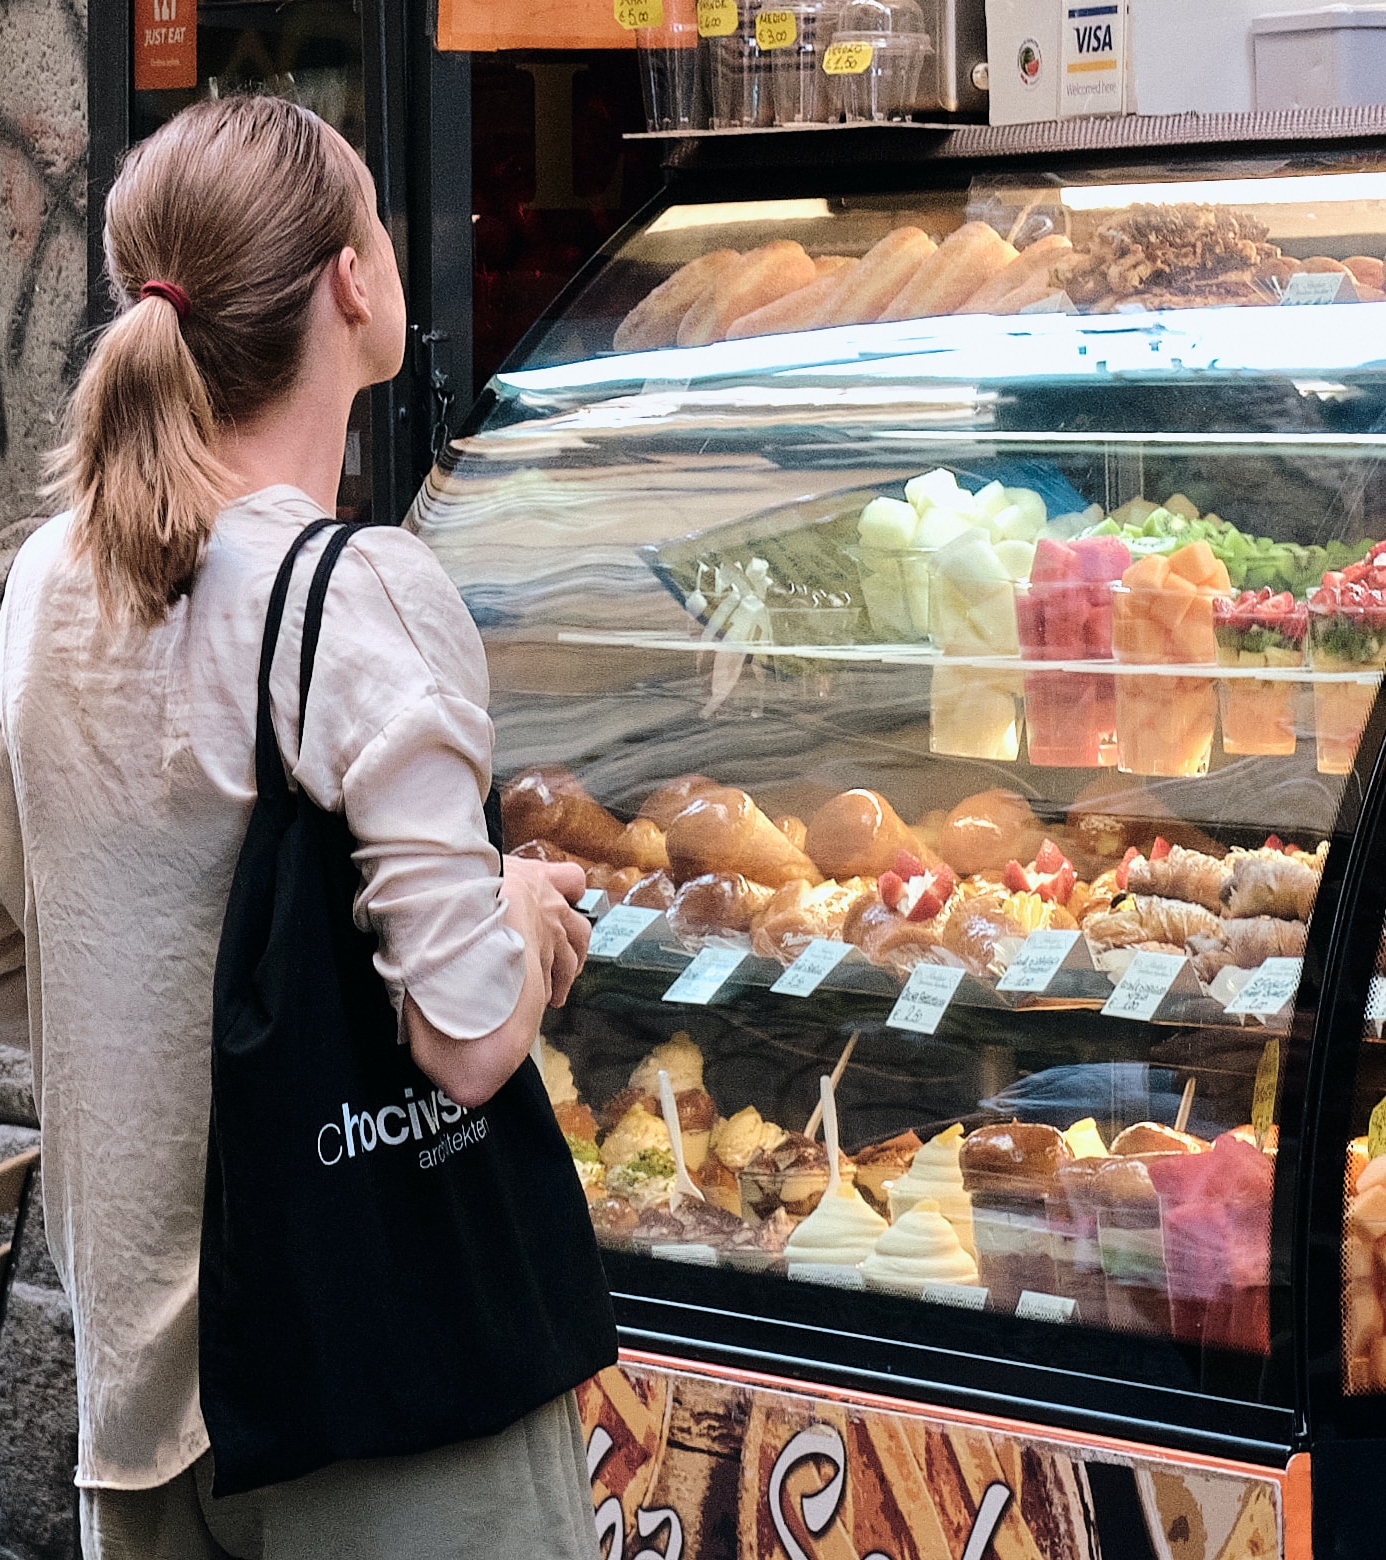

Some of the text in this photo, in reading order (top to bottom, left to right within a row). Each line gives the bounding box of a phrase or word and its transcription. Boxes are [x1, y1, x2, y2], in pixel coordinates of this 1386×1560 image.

[144, 26, 186, 48] JUST EAT
[1074, 23, 1113, 54] VISA
